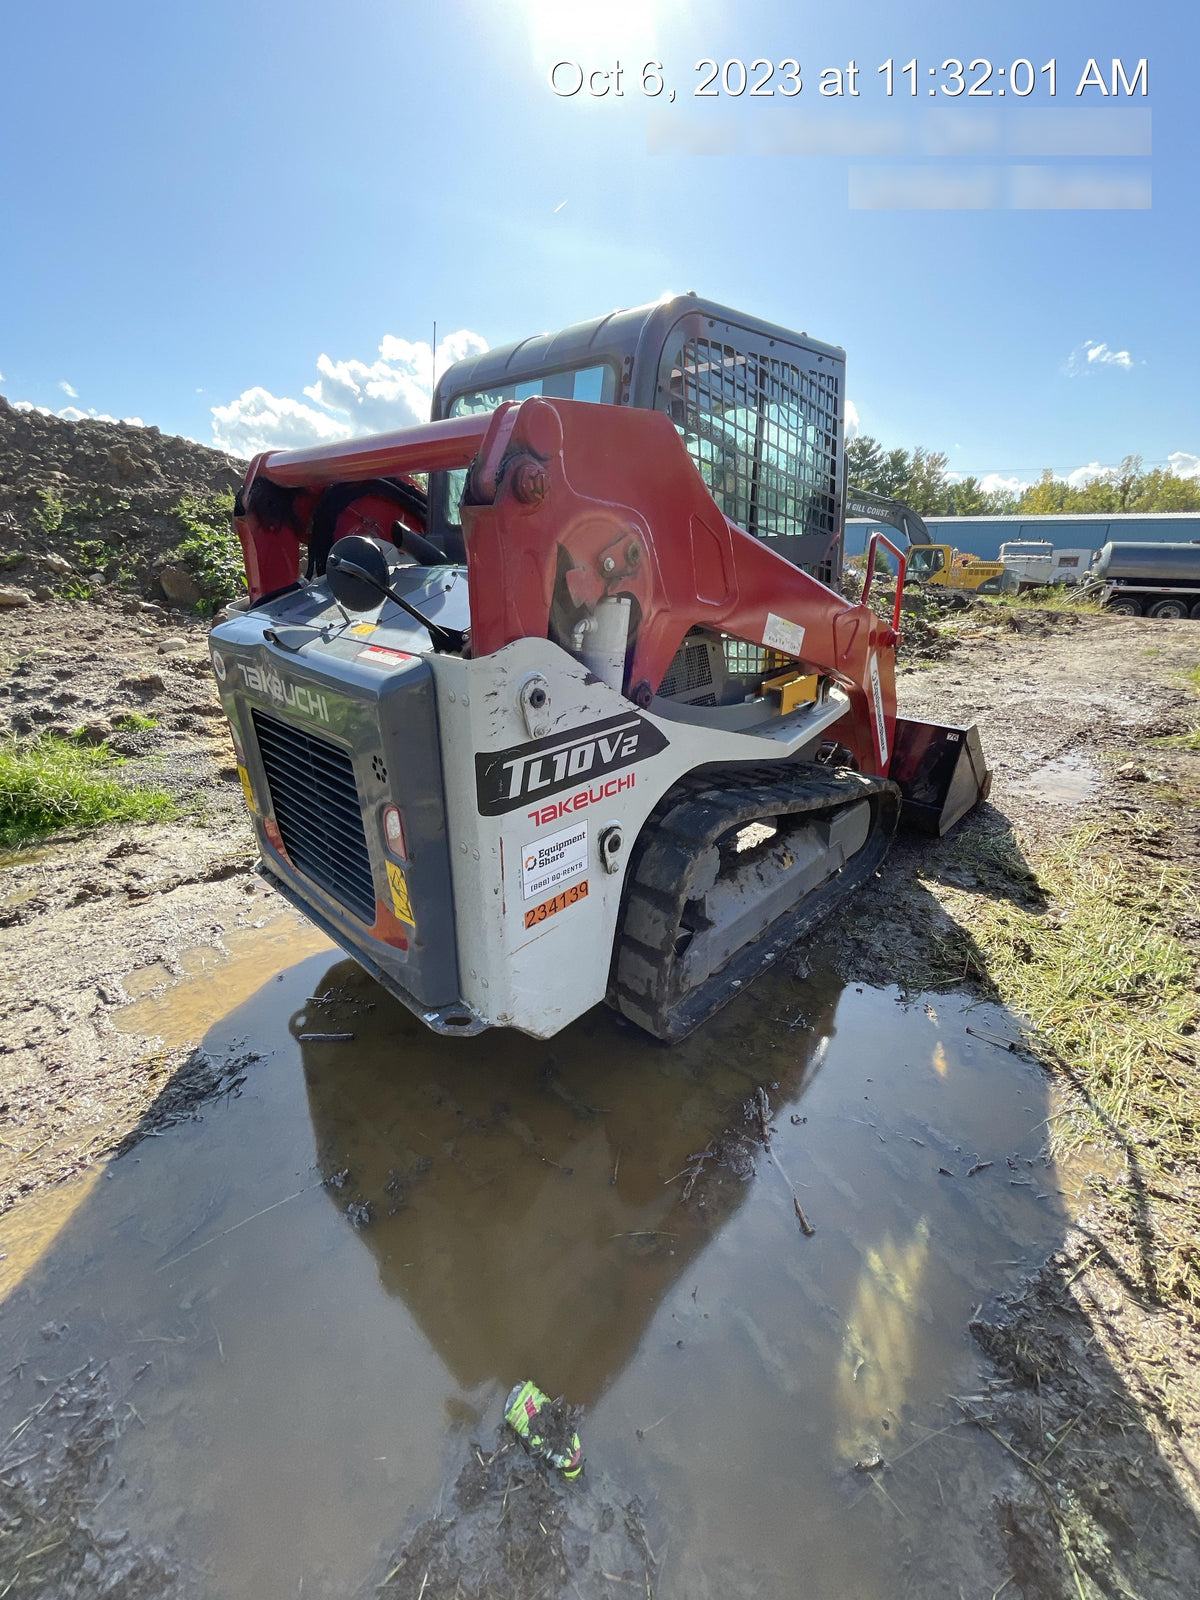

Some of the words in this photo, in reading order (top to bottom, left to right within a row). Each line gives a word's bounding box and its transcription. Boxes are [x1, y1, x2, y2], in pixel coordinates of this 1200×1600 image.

[851, 503, 865, 513] GILL
[948, 733, 958, 741] 76
[502, 719, 641, 799] TL10V2
[528, 773, 636, 827] TAKEUCHI
[538, 831, 587, 859] Equipment
[538, 851, 566, 868] Share
[526, 881, 589, 928] 234139
